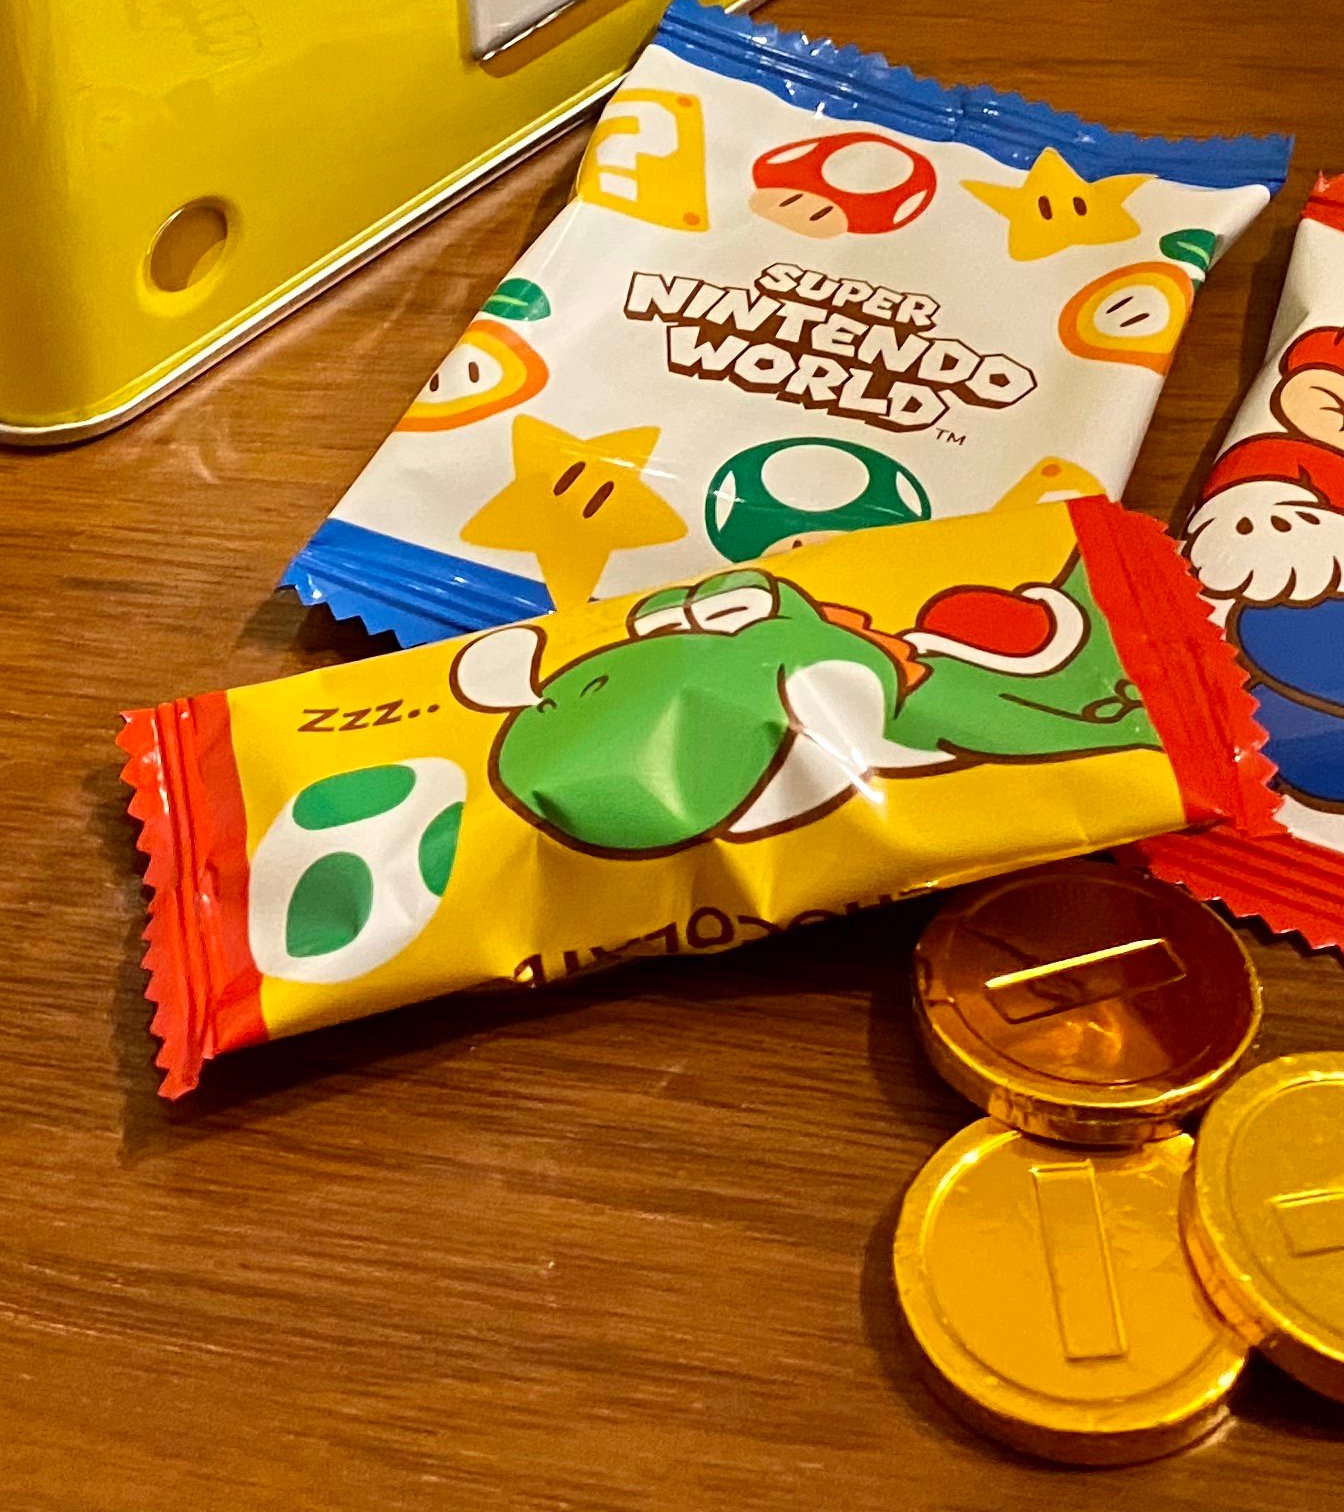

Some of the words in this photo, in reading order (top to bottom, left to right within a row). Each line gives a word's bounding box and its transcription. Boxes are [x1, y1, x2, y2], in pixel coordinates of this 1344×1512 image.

[623, 271, 1038, 410] NINTENDO
[755, 262, 941, 331] SUPER
[666, 324, 950, 433] WORLD
[935, 427, 967, 446] TM
